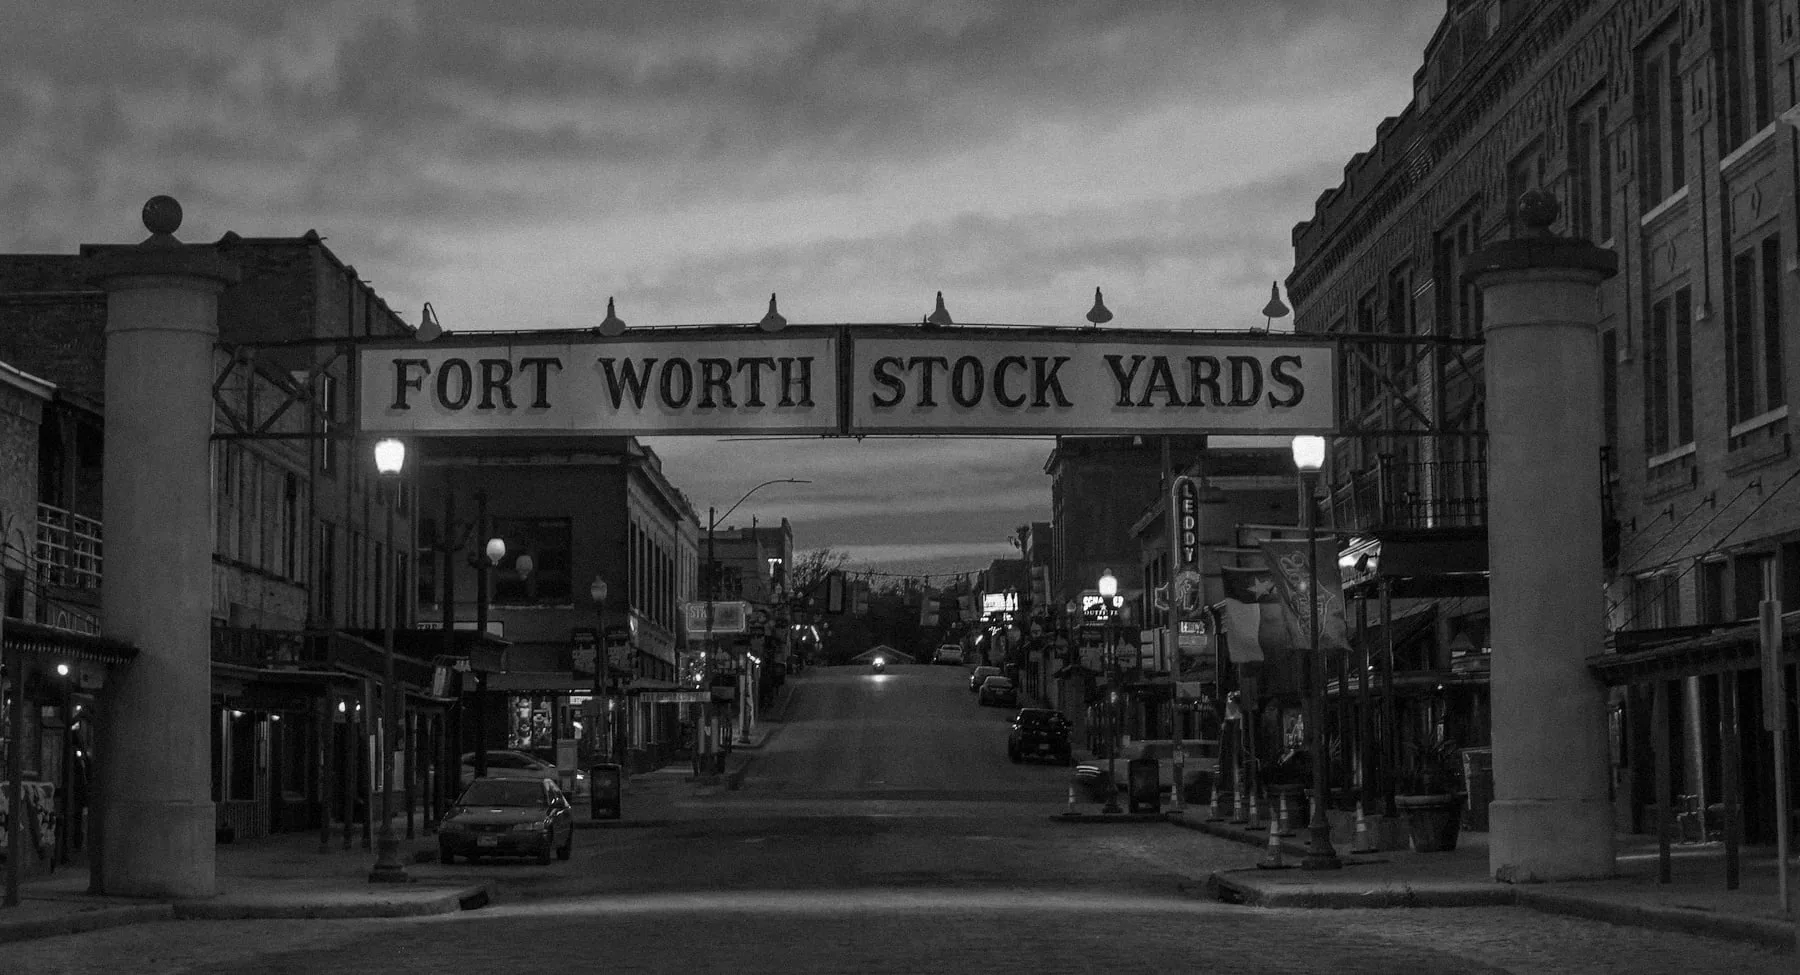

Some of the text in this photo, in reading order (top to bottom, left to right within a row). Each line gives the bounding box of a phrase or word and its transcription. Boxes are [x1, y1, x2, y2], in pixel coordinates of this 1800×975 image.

[391, 354, 1304, 410] FORT WORTH STOCK YARDS
[1183, 484, 1197, 563] LEDDY
